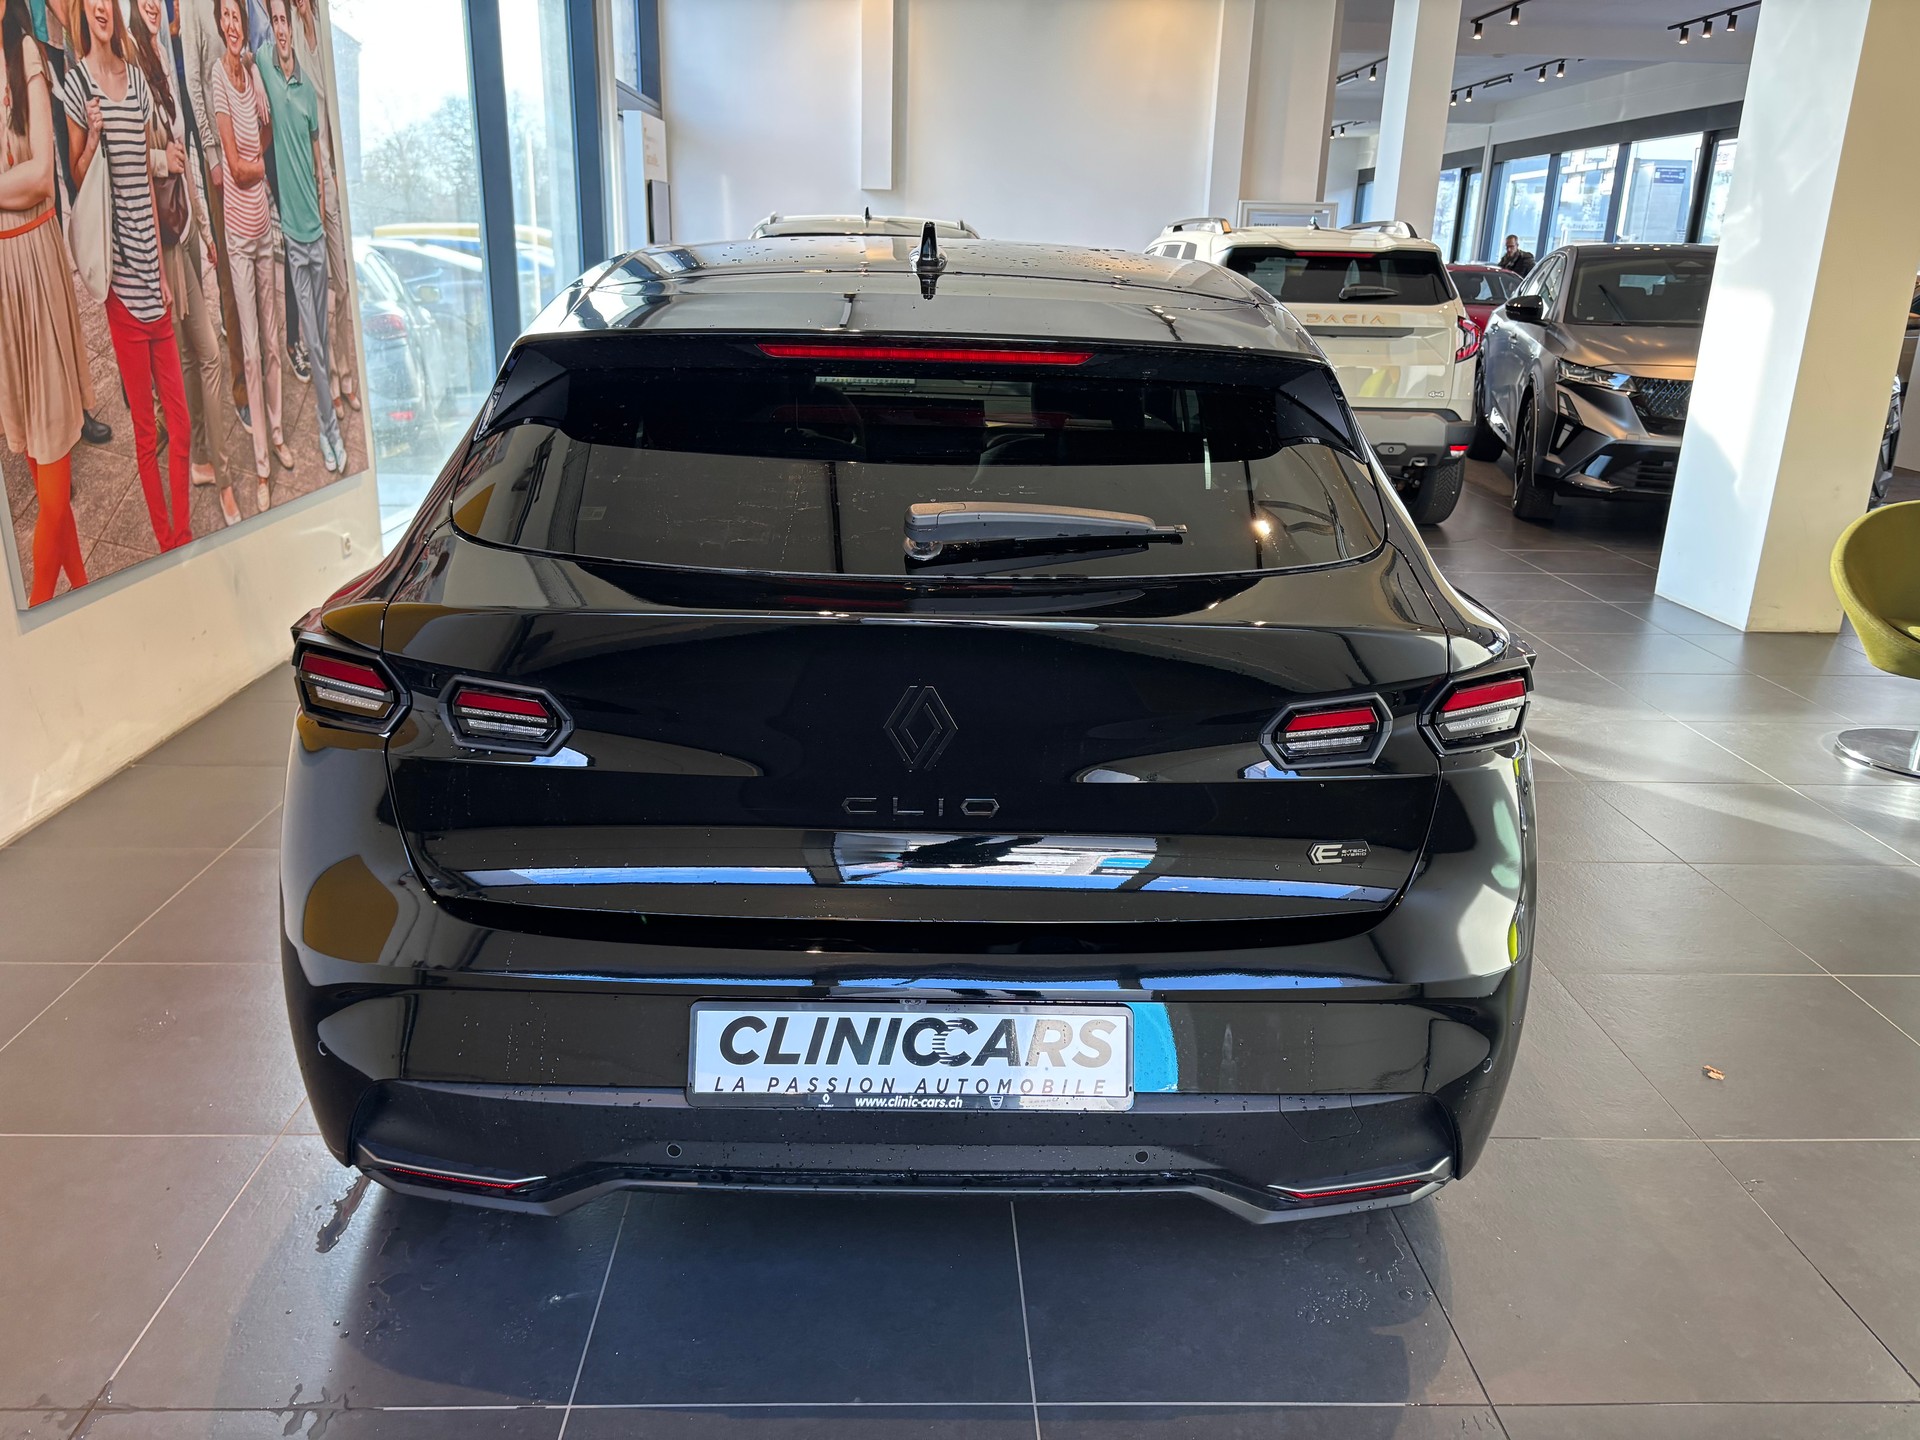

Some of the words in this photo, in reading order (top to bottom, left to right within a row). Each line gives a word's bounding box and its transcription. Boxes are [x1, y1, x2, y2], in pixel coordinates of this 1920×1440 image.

[1306, 313, 1385, 325] DACIA
[841, 797, 1000, 816] CLIO
[714, 1077, 745, 1092] LA
[767, 1077, 895, 1093] PASSION
[914, 1078, 1106, 1095] AUTOMOBILE
[855, 1096, 963, 1108] www.clinic-cars.ch
